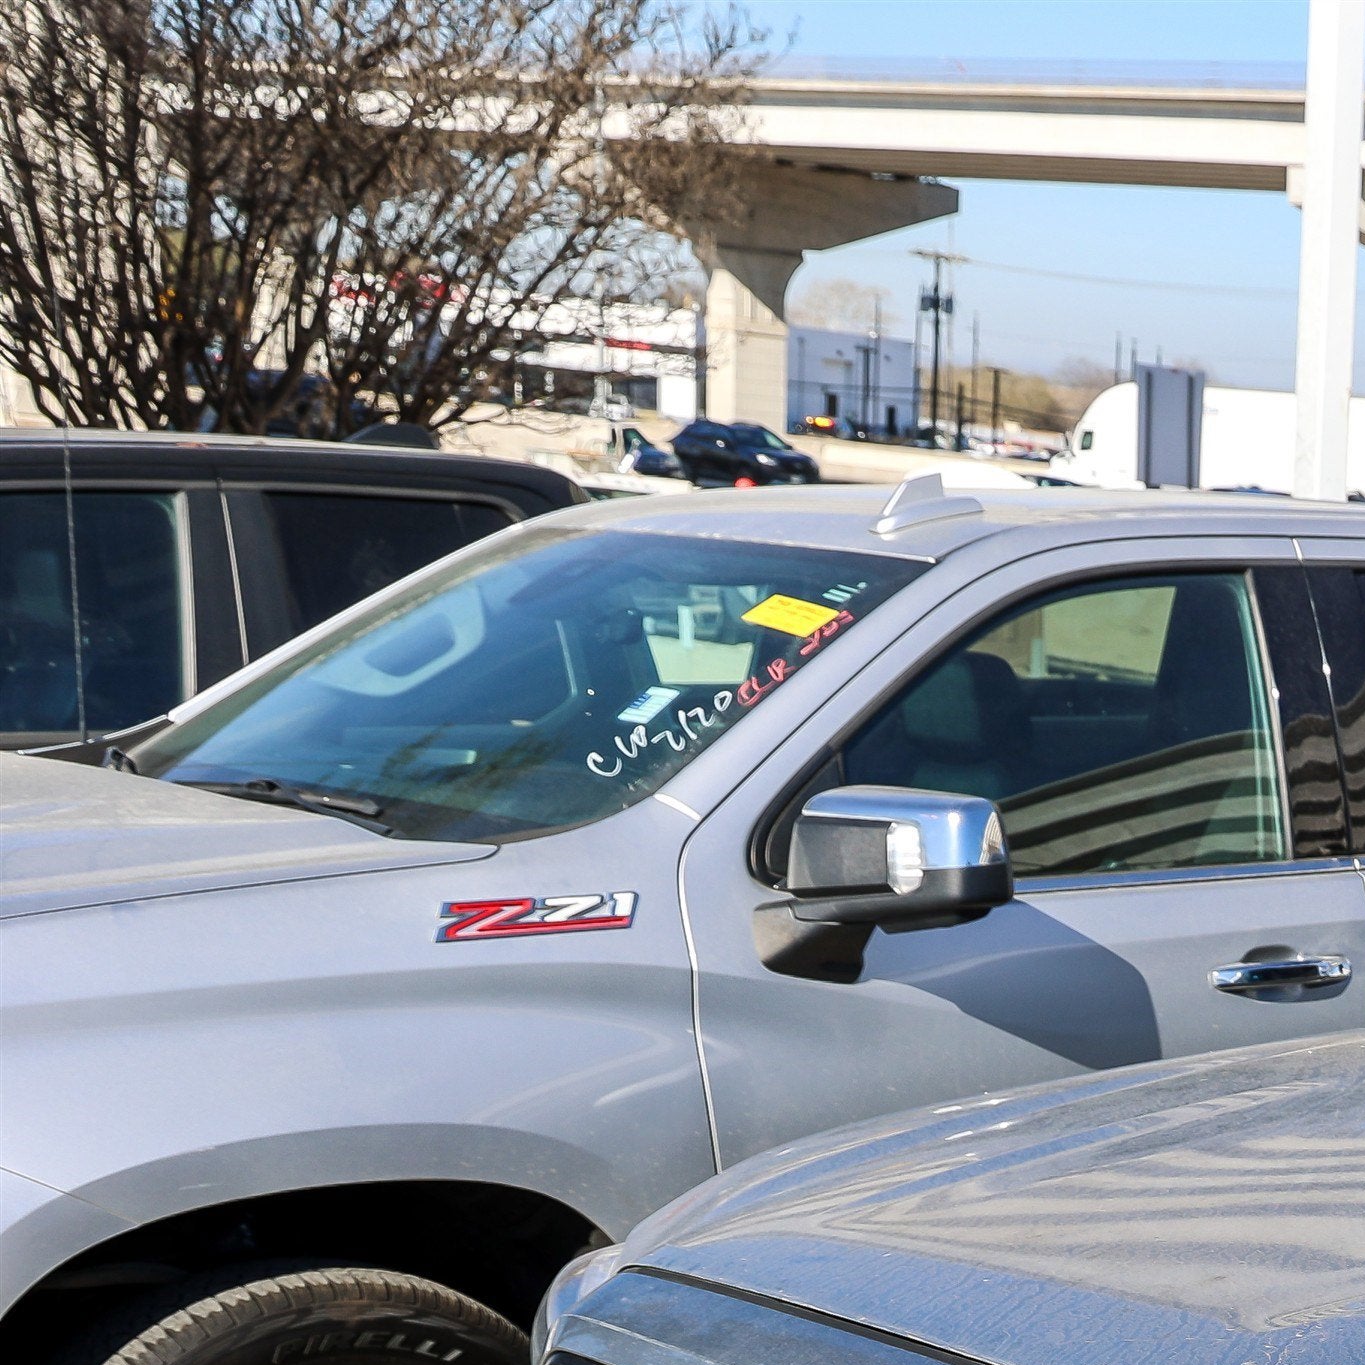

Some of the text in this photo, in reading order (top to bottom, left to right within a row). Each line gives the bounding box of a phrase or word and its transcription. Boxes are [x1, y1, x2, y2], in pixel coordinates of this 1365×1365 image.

[651, 690, 733, 751] 2/20
[436, 891, 639, 943] Z71
[271, 1329, 463, 1364] PIRELLI
